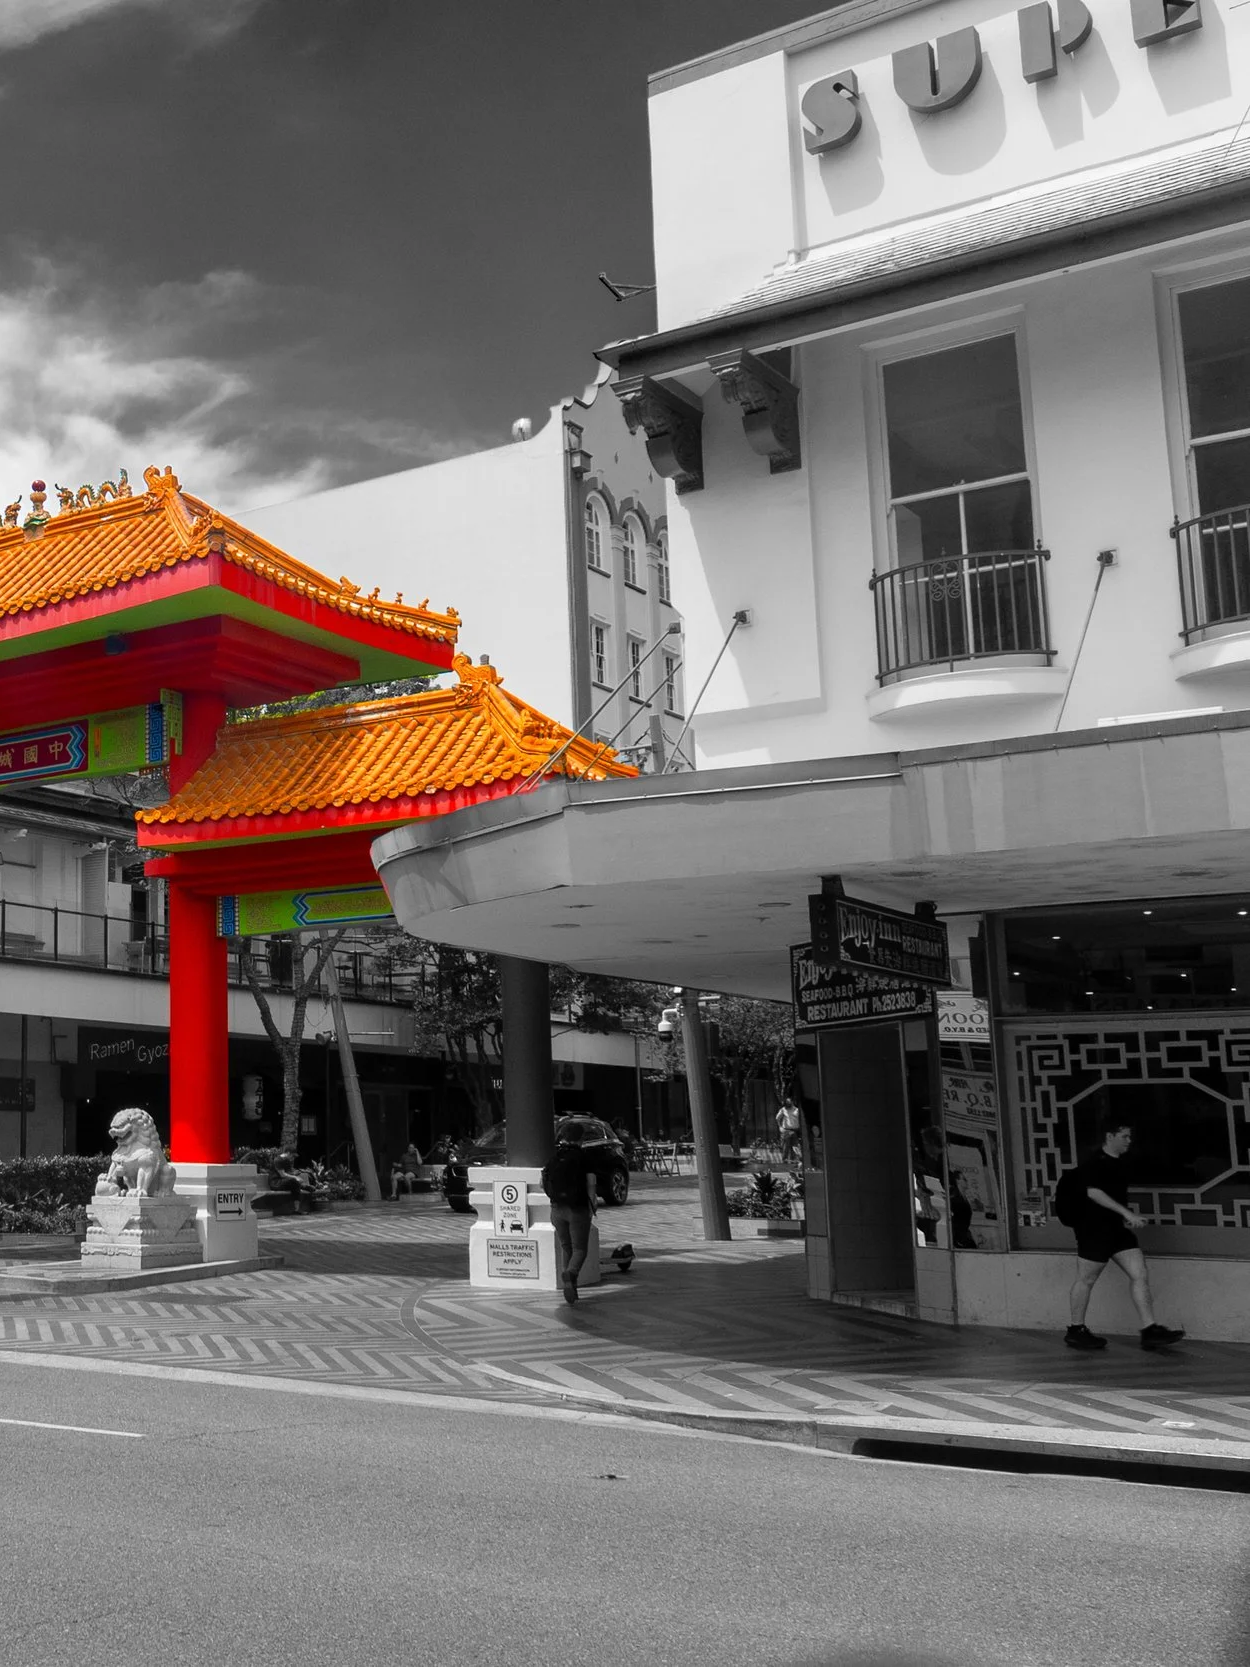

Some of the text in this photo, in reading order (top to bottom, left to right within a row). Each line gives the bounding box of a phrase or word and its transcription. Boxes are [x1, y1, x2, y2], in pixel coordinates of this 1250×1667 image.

[903, 936, 941, 959] RESTAURANT
[807, 998, 868, 1021] RESTAURANT
[90, 1038, 169, 1065] Ramen Gyoz
[217, 1192, 244, 1204] ENTRY
[506, 1188, 514, 1200] 5
